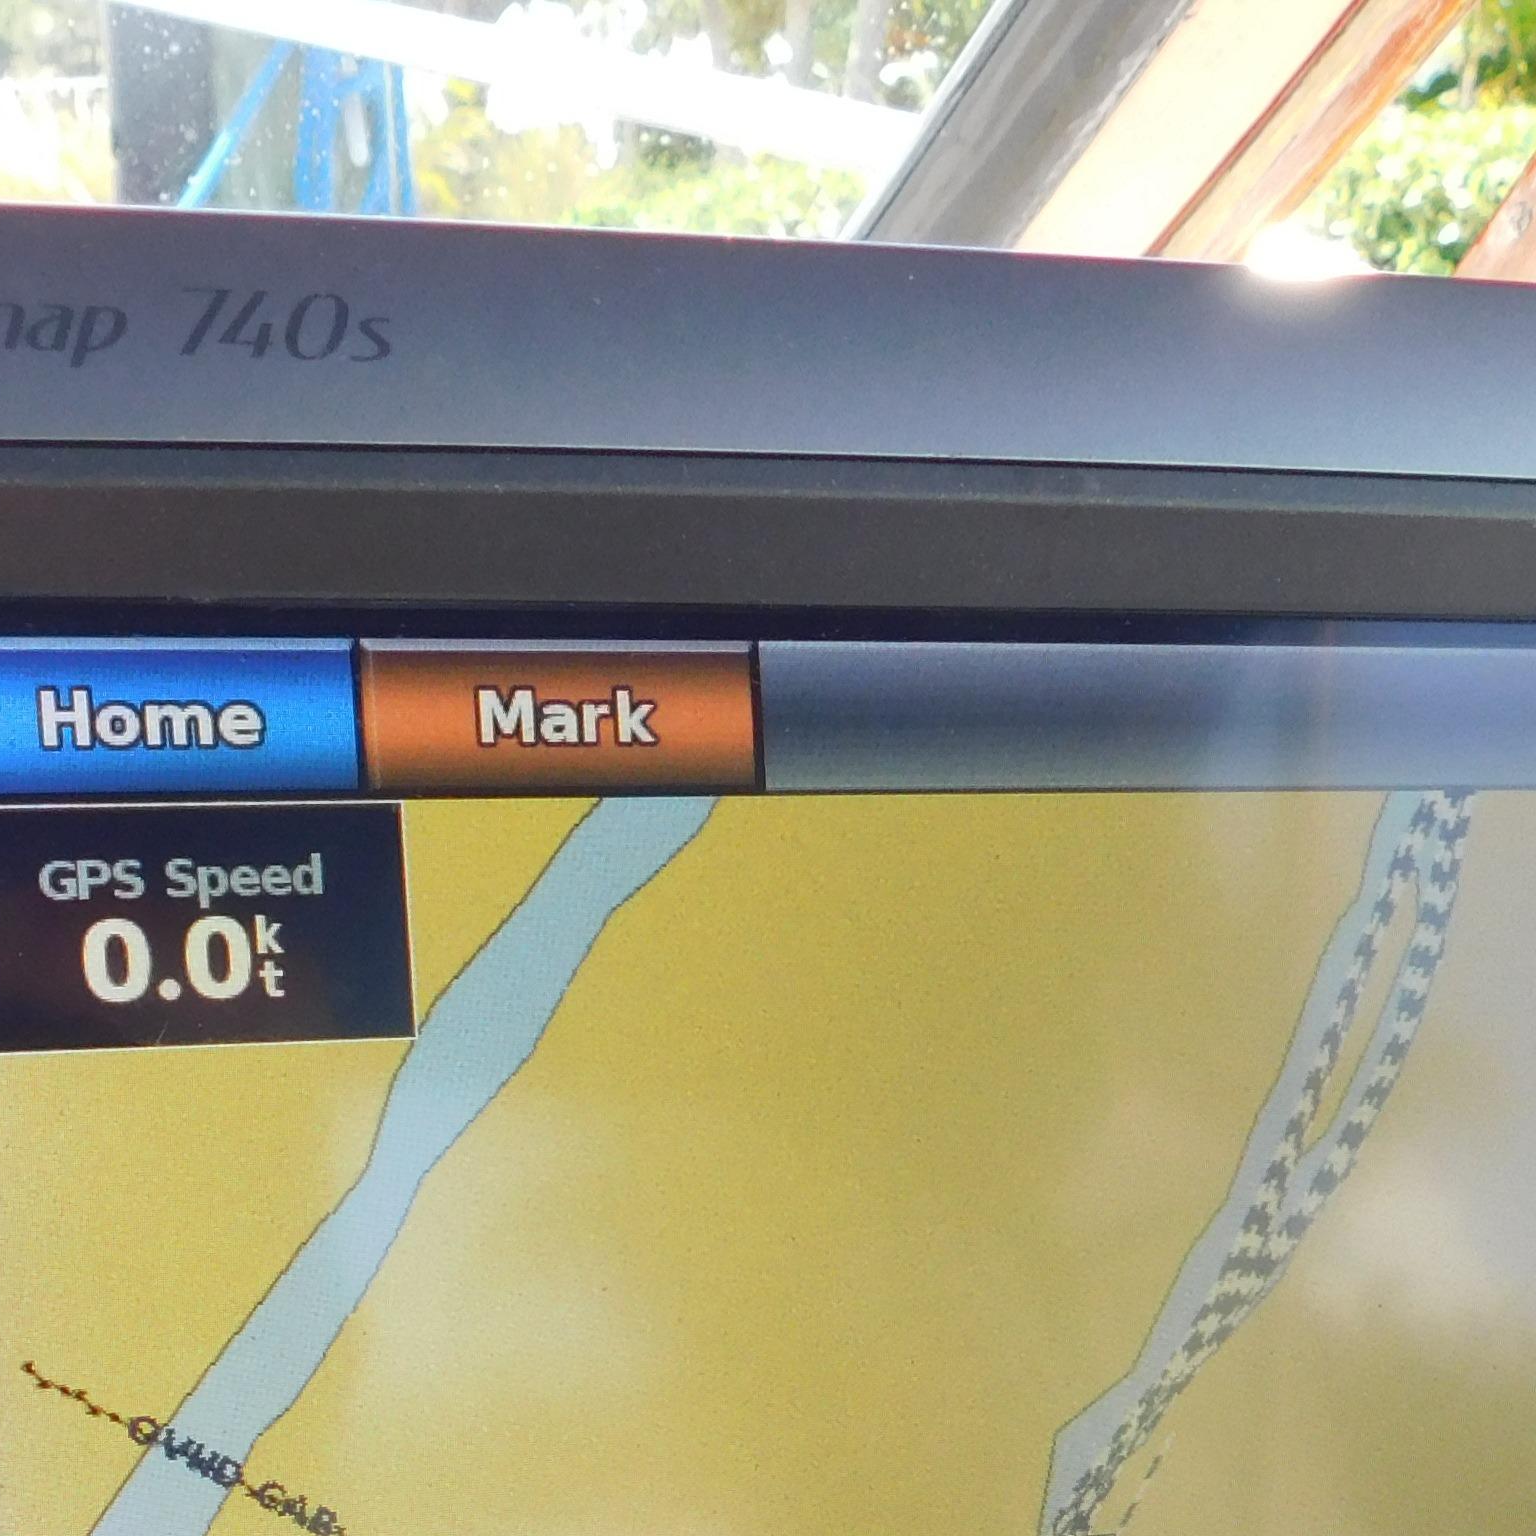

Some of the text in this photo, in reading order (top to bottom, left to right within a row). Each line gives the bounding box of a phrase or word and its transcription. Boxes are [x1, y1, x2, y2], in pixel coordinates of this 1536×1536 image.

[180, 286, 392, 362] 740s
[36, 684, 265, 752] Home
[474, 686, 659, 747] Mark
[37, 852, 325, 908] GPS Speed
[81, 914, 251, 1004] 0.0
